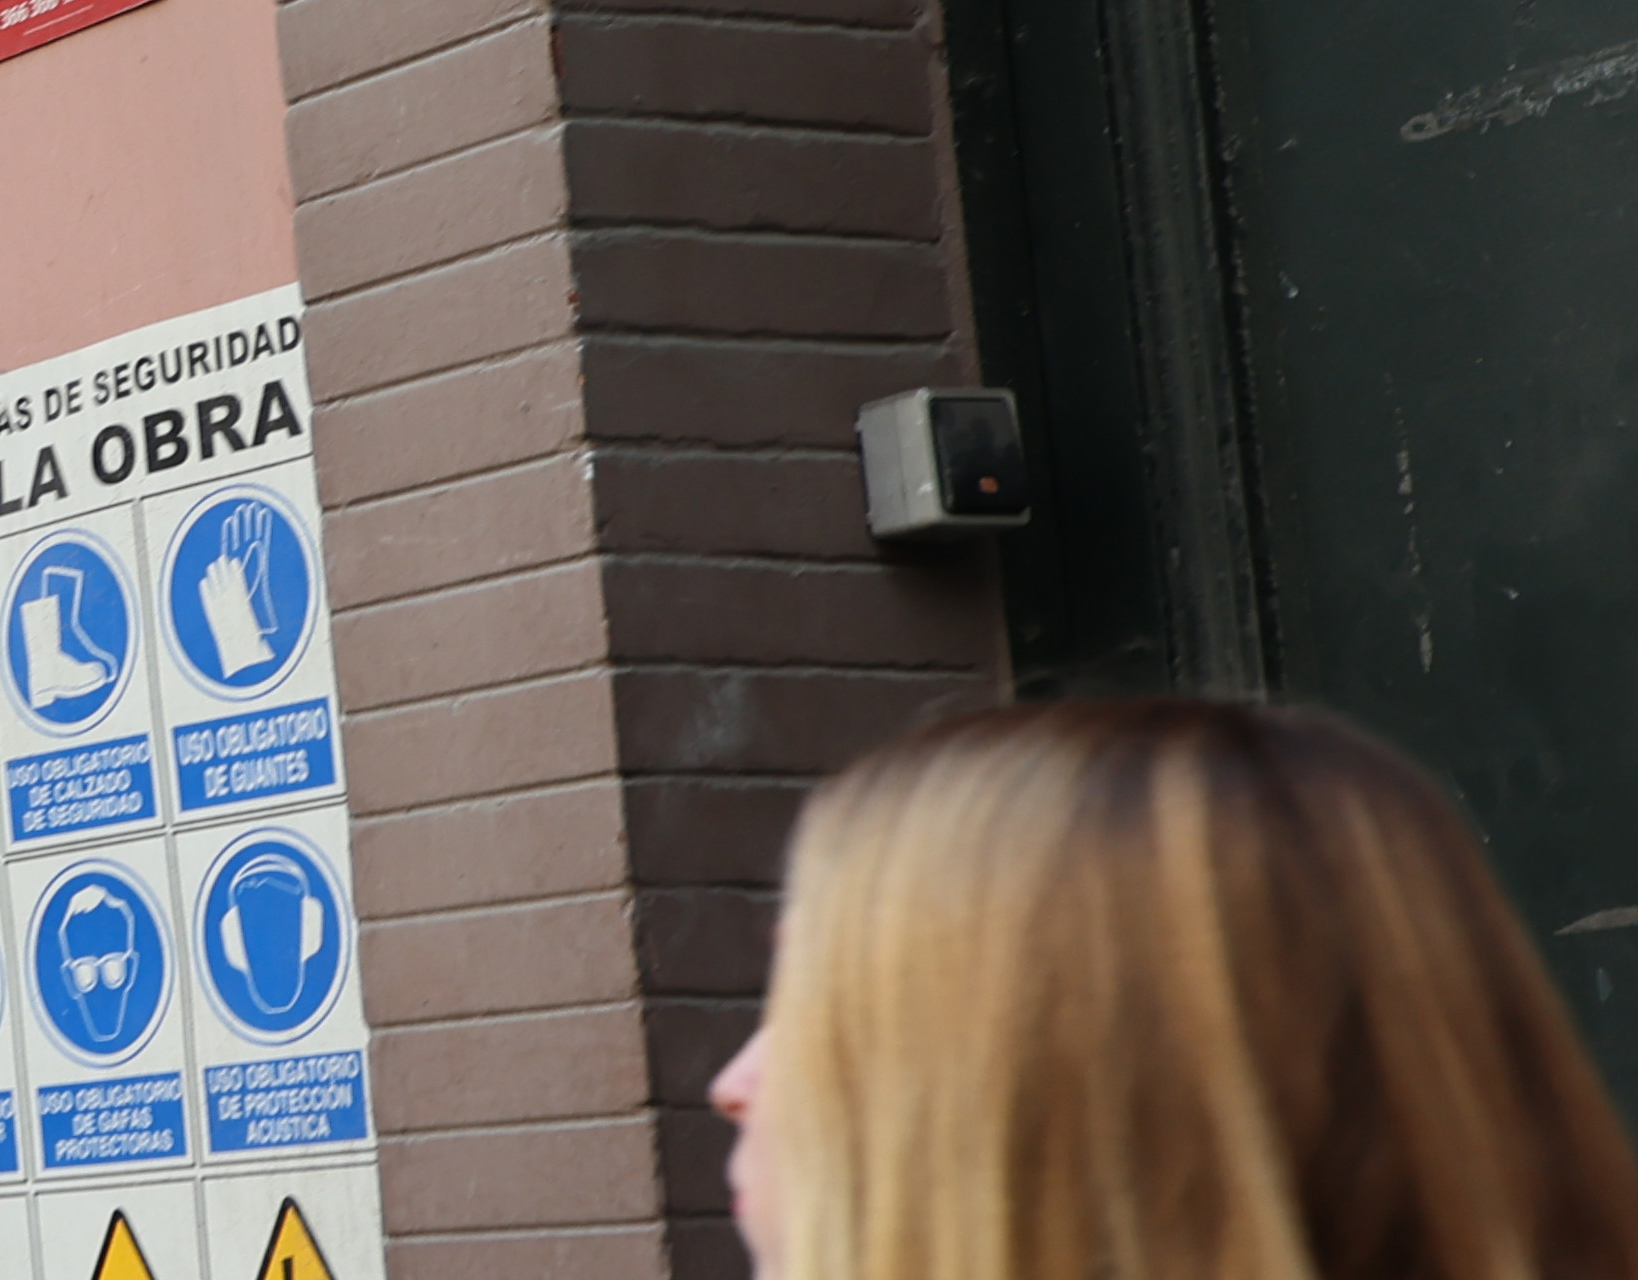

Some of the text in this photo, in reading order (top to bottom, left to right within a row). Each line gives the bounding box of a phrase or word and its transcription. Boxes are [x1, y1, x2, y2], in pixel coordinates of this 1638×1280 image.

[44, 378, 84, 423] DE
[93, 316, 301, 405] SEGURIDAD
[92, 379, 302, 485] OBRA
[178, 707, 328, 765] USO OBLIGATORIO
[42, 740, 151, 783] OBLIGATORIO
[203, 750, 309, 798] DE GUANTES
[28, 769, 132, 808] DE CALZADO
[23, 792, 142, 833] DE SEGURIDAD
[209, 1056, 359, 1094] USO OBLIGATORIO
[40, 1079, 183, 1117] USO OBLIGATORIO
[219, 1092, 242, 1121] DE
[72, 1109, 152, 1137] DE GAFAS
[55, 1129, 174, 1164] PROTECTORAS
